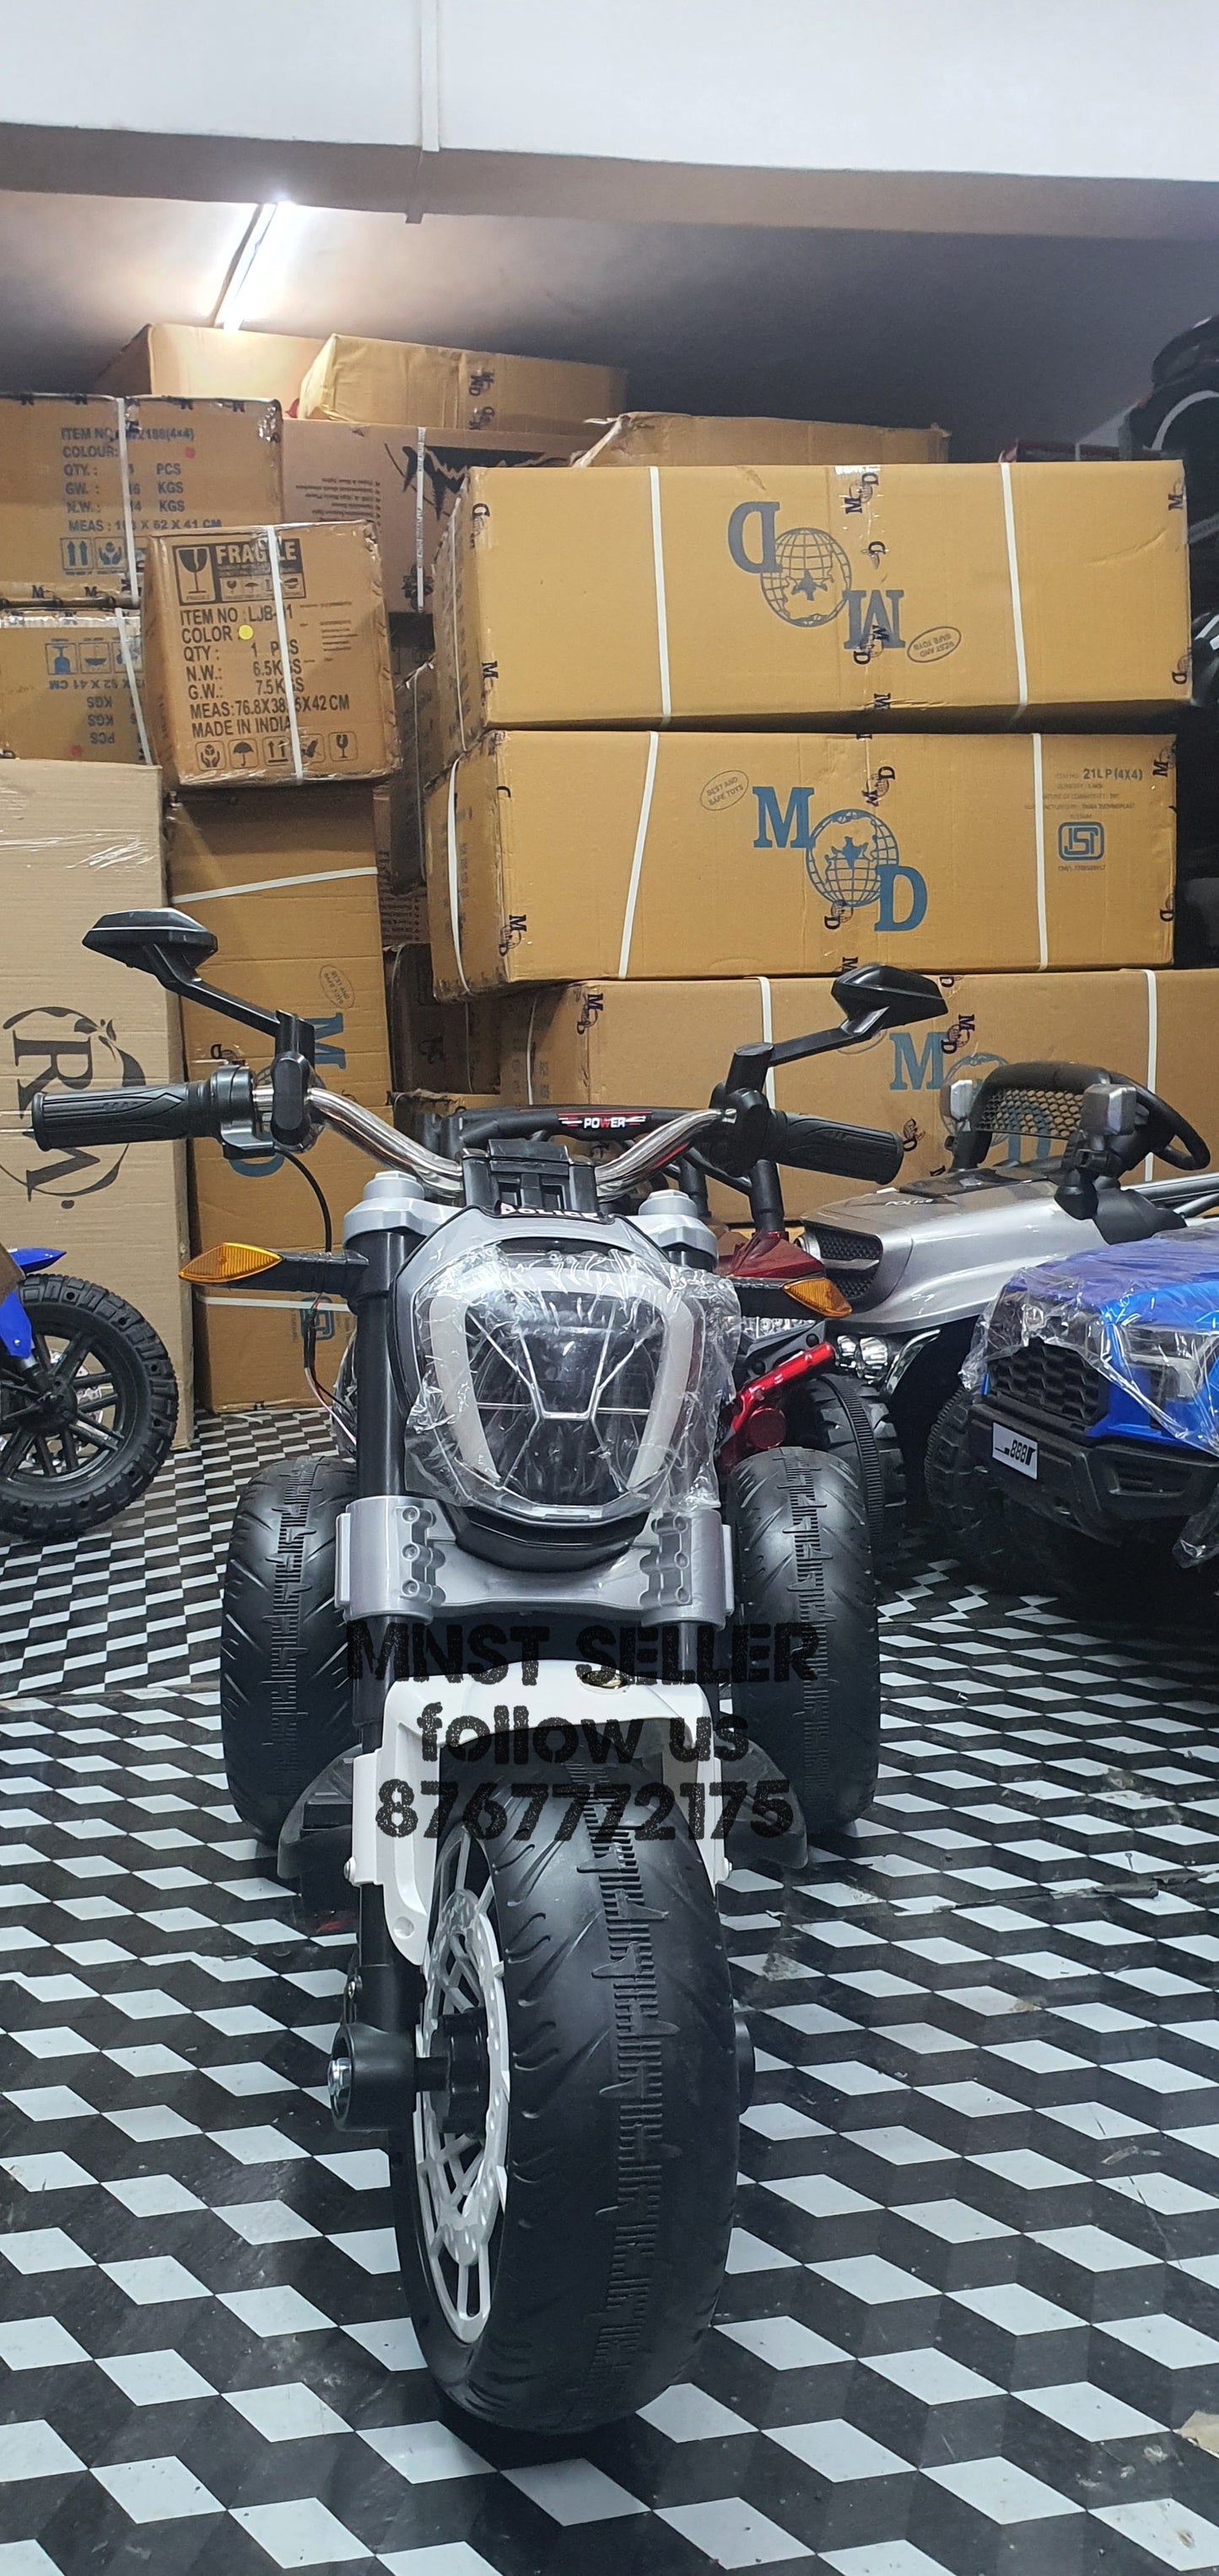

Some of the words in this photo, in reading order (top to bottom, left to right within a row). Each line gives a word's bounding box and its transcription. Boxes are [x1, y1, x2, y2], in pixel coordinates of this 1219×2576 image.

[61, 428, 91, 440] ITEM
[156, 463, 181, 475] PCS
[158, 482, 184, 493] KGS
[159, 500, 186, 512] KGS
[215, 541, 297, 564] FRAGLE
[181, 608, 213, 625] ITEM
[218, 607, 238, 623] NO
[247, 604, 294, 622] LJB-1
[181, 625, 233, 644] COLOR
[270, 639, 299, 656] PS
[87, 696, 112, 709] KGS
[329, 694, 349, 710] CM
[88, 714, 114, 726] KGS
[191, 720, 234, 738] MADE
[237, 719, 251, 735] IN
[90, 732, 115, 744] PCS
[752, 786, 816, 849] M
[874, 865, 928, 932] D
[584, 1118, 626, 1129] POWER
